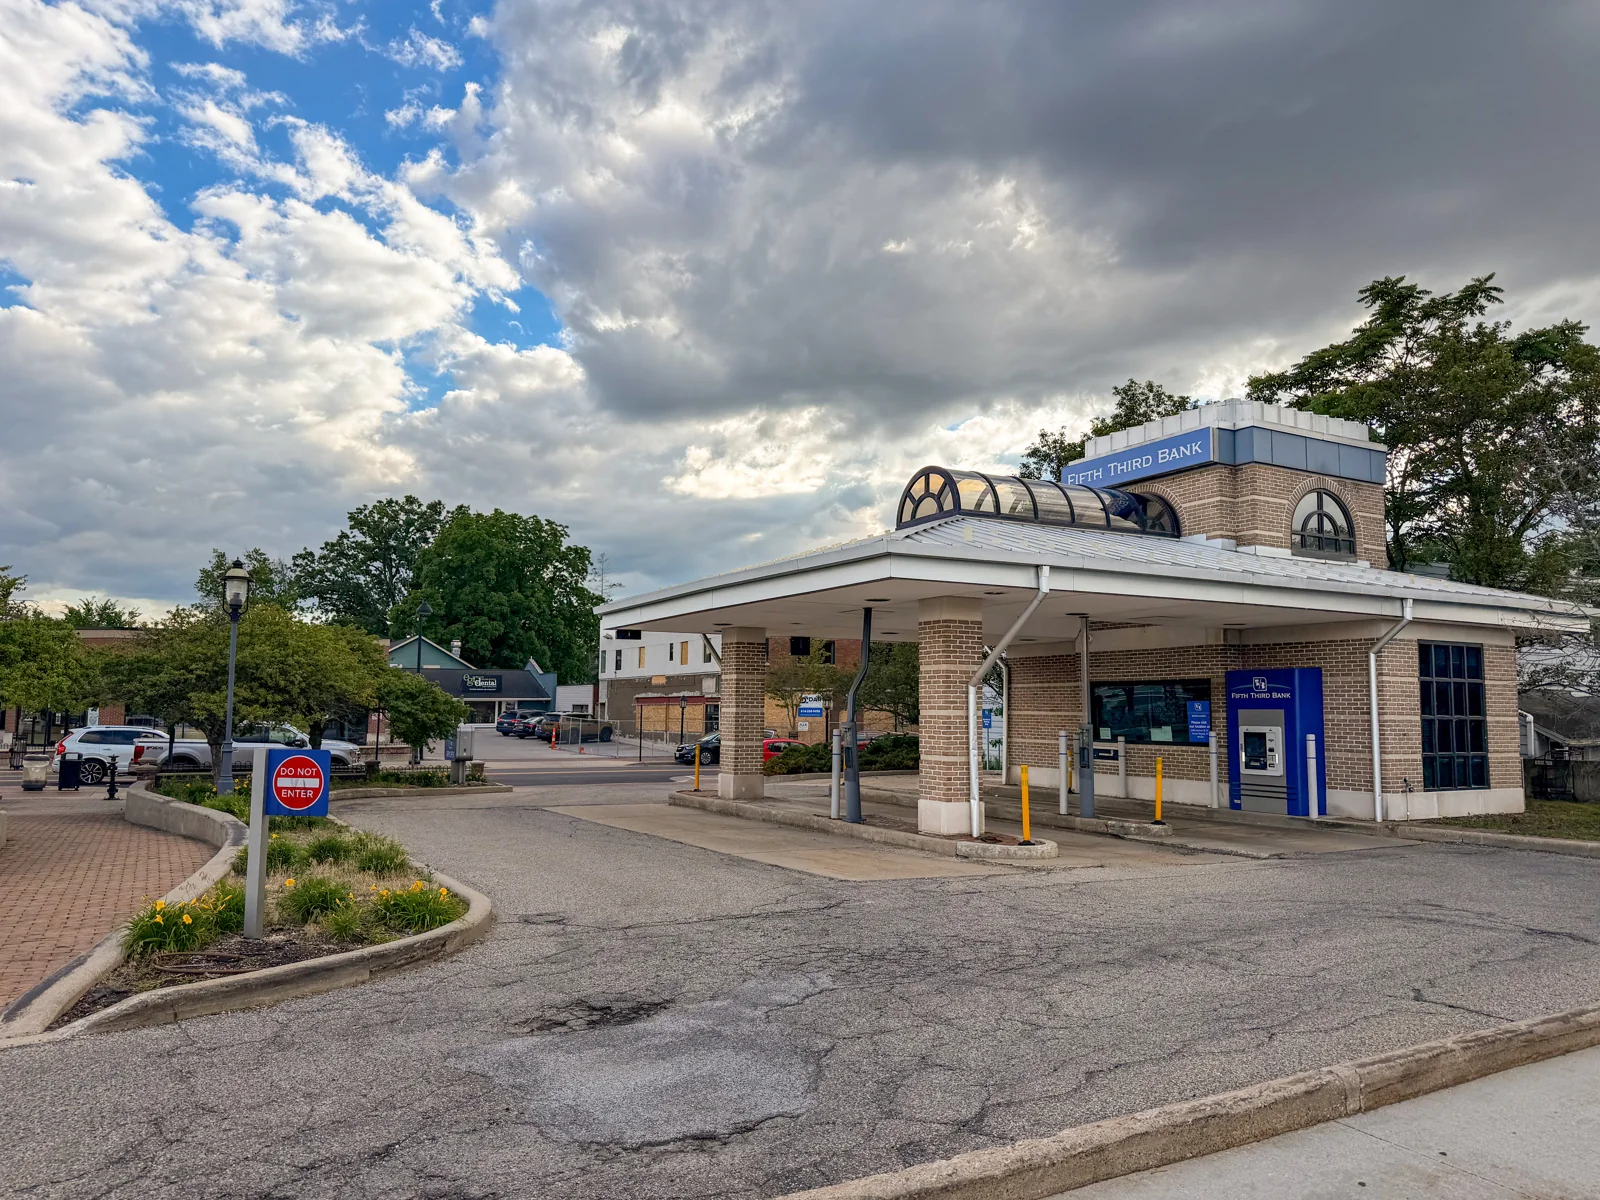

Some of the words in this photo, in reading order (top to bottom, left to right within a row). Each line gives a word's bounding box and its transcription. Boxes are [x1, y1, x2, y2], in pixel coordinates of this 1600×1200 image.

[1068, 468, 1102, 484] FIFTH
[1108, 455, 1152, 476] THIRD
[1158, 441, 1202, 463] BANK
[474, 678, 496, 686] dental
[280, 768, 294, 776] DO
[297, 768, 317, 776] NOT
[282, 789, 314, 798] ENTER
